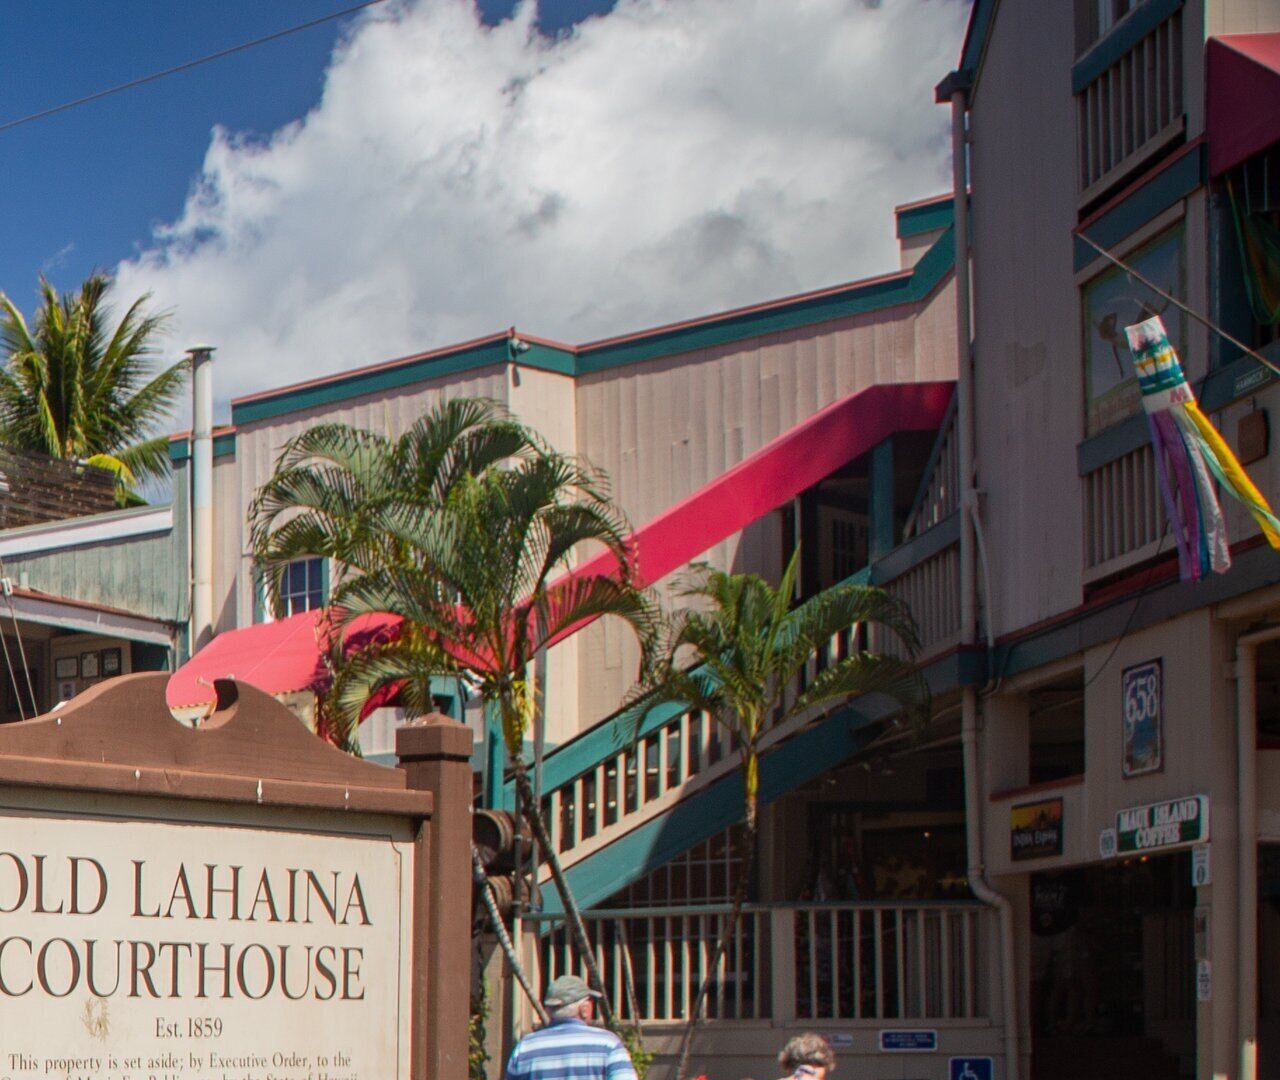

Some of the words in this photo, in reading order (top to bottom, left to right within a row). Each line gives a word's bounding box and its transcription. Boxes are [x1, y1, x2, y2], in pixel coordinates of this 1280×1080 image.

[1124, 673, 1159, 723] 658
[1153, 798, 1199, 827] ISLAND
[1134, 821, 1182, 850] COFFEE
[130, 859, 374, 926] LAHAINA
[155, 1017, 183, 1039] Est.
[187, 1017, 224, 1039] 1859
[8, 1053, 39, 1071] This
[45, 1055, 102, 1074] property
[108, 1054, 118, 1069] is
[123, 1054, 141, 1069] set
[147, 1052, 184, 1072] aside;
[189, 1052, 203, 1073] by
[209, 1051, 267, 1068] Executive
[272, 1051, 312, 1071] Order,
[317, 1054, 329, 1068] to
[334, 1051, 352, 1068] the
